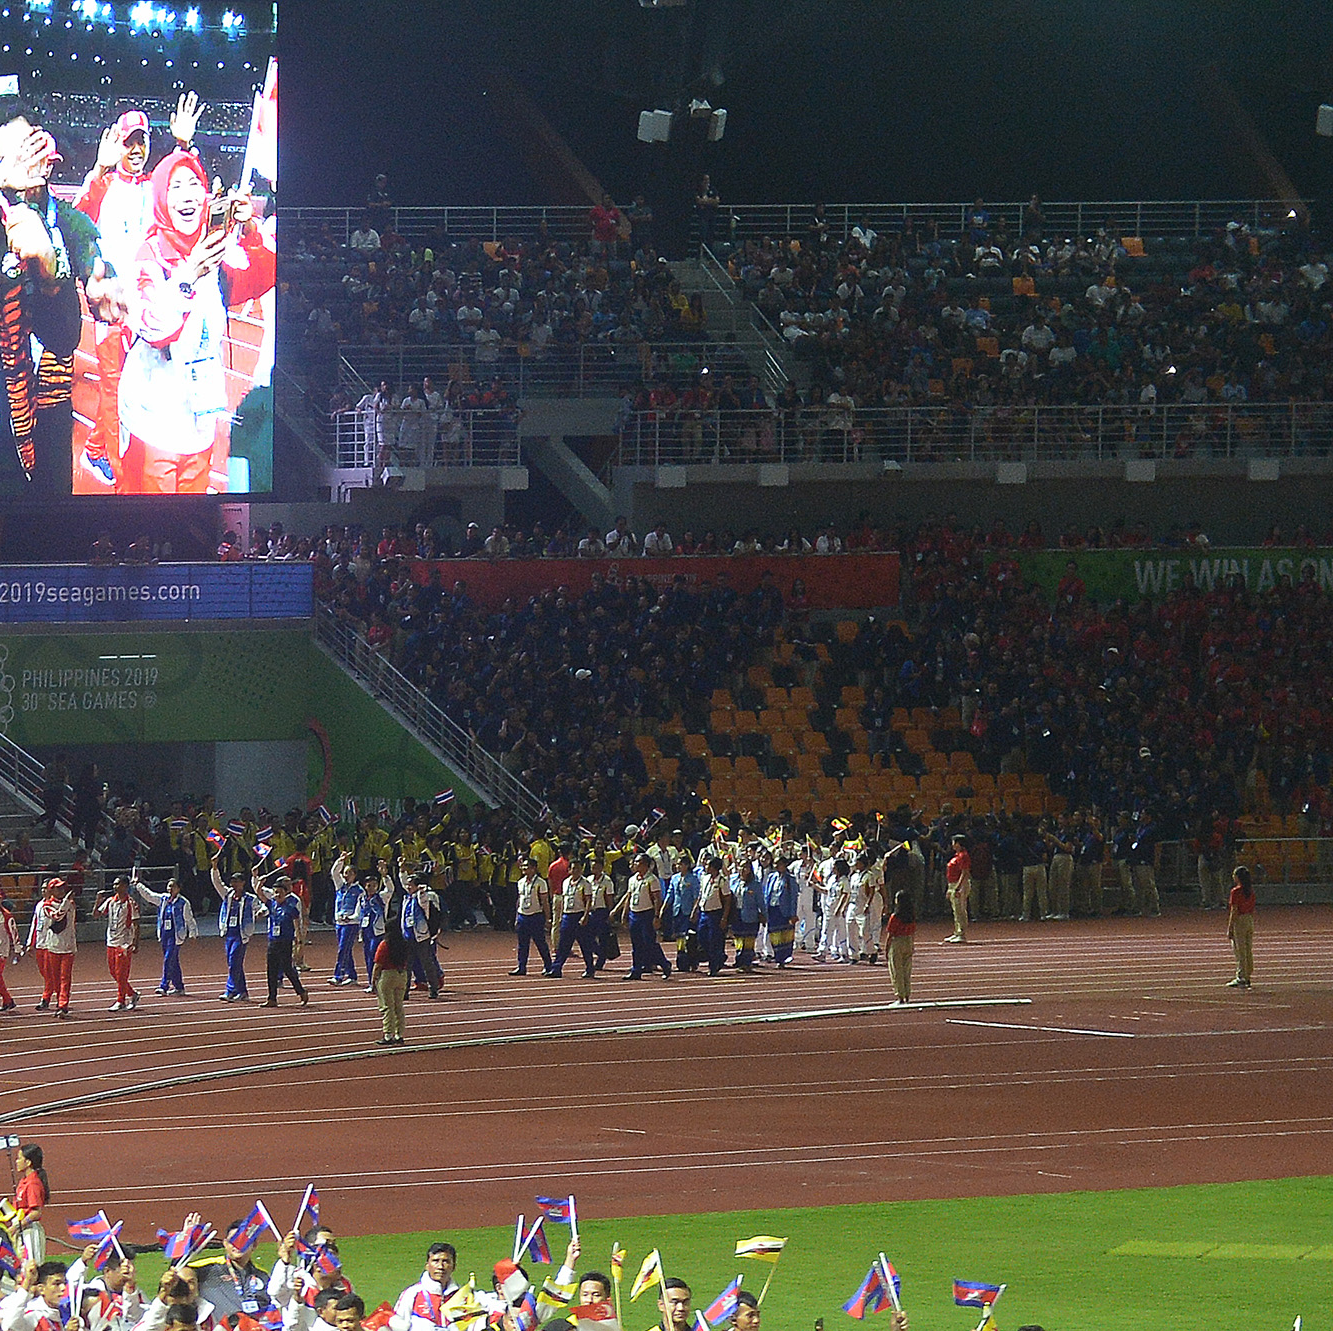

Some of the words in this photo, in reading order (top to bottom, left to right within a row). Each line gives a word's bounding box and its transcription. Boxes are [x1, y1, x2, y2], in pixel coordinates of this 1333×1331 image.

[1133, 559, 1180, 594] WE
[22, 668, 121, 689] PHILIPPINES
[124, 667, 158, 687] 2019
[47, 691, 78, 711] SEA
[82, 690, 138, 710] GAMES
